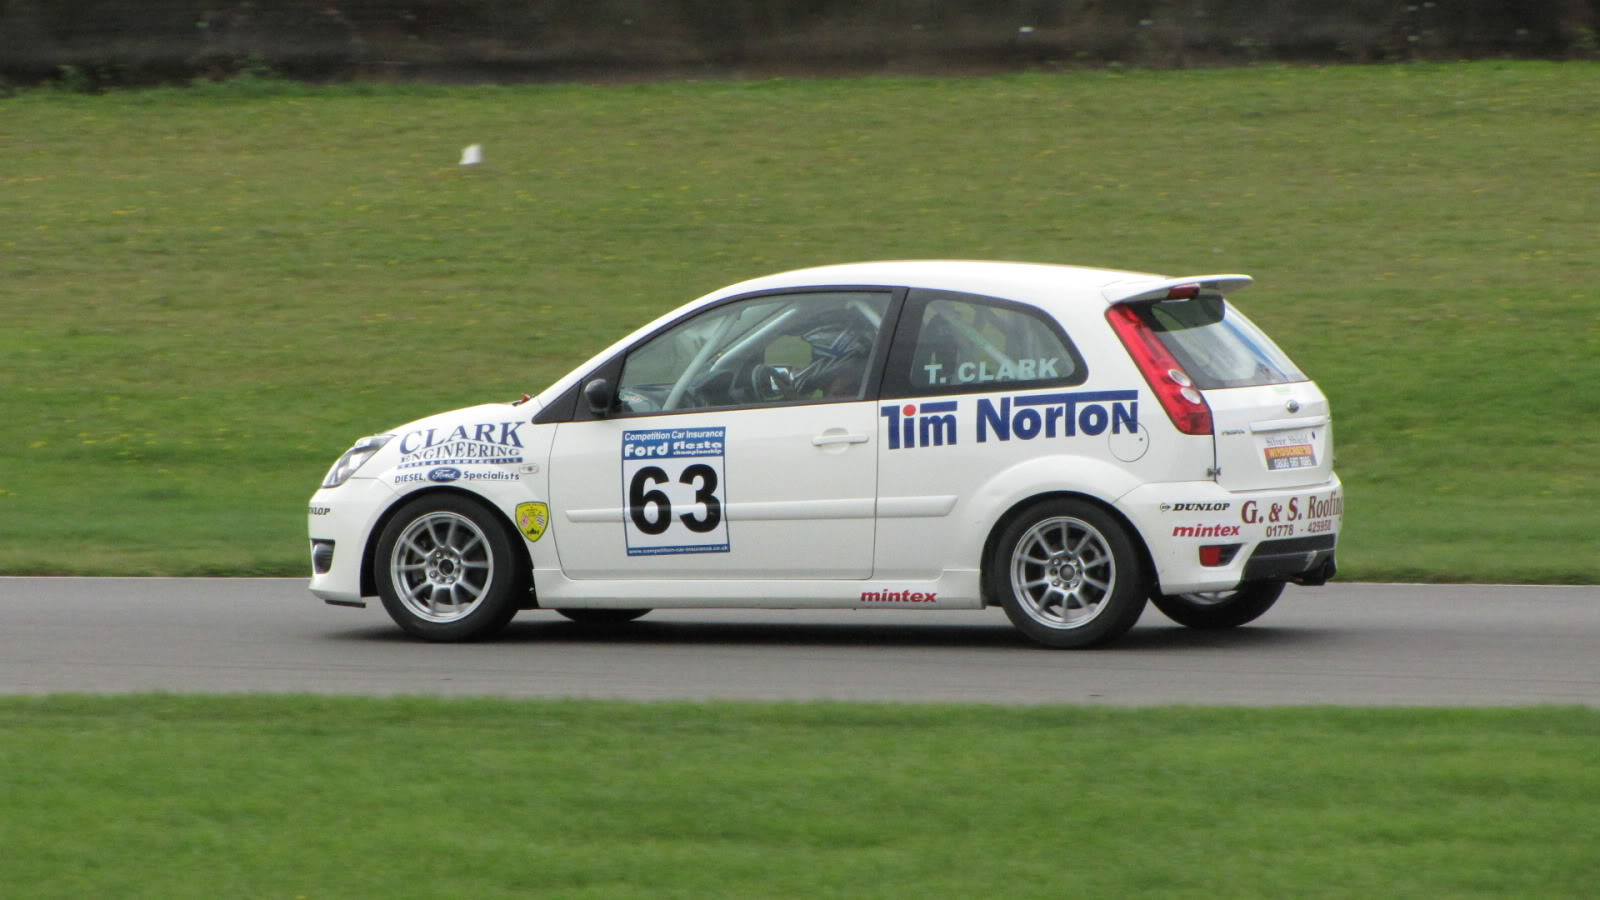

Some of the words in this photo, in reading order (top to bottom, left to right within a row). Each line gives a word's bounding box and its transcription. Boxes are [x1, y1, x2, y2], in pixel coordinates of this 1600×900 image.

[924, 363, 947, 384] T.
[957, 357, 1060, 382] CLARK
[400, 421, 526, 455] CLARK
[624, 432, 670, 442] Competition
[671, 430, 685, 439] Car
[686, 429, 723, 439] Insurance
[401, 442, 520, 462] ENGINEERING
[463, 470, 520, 482] Specialists
[629, 464, 720, 535] 63
[1173, 503, 1230, 511] DUNLOP
[1241, 500, 1264, 525] G.
[1268, 502, 1283, 523] &
[1287, 496, 1302, 521] S.
[1172, 524, 1240, 537] mintex
[1266, 524, 1294, 538] 01778
[861, 589, 937, 602] mintex
